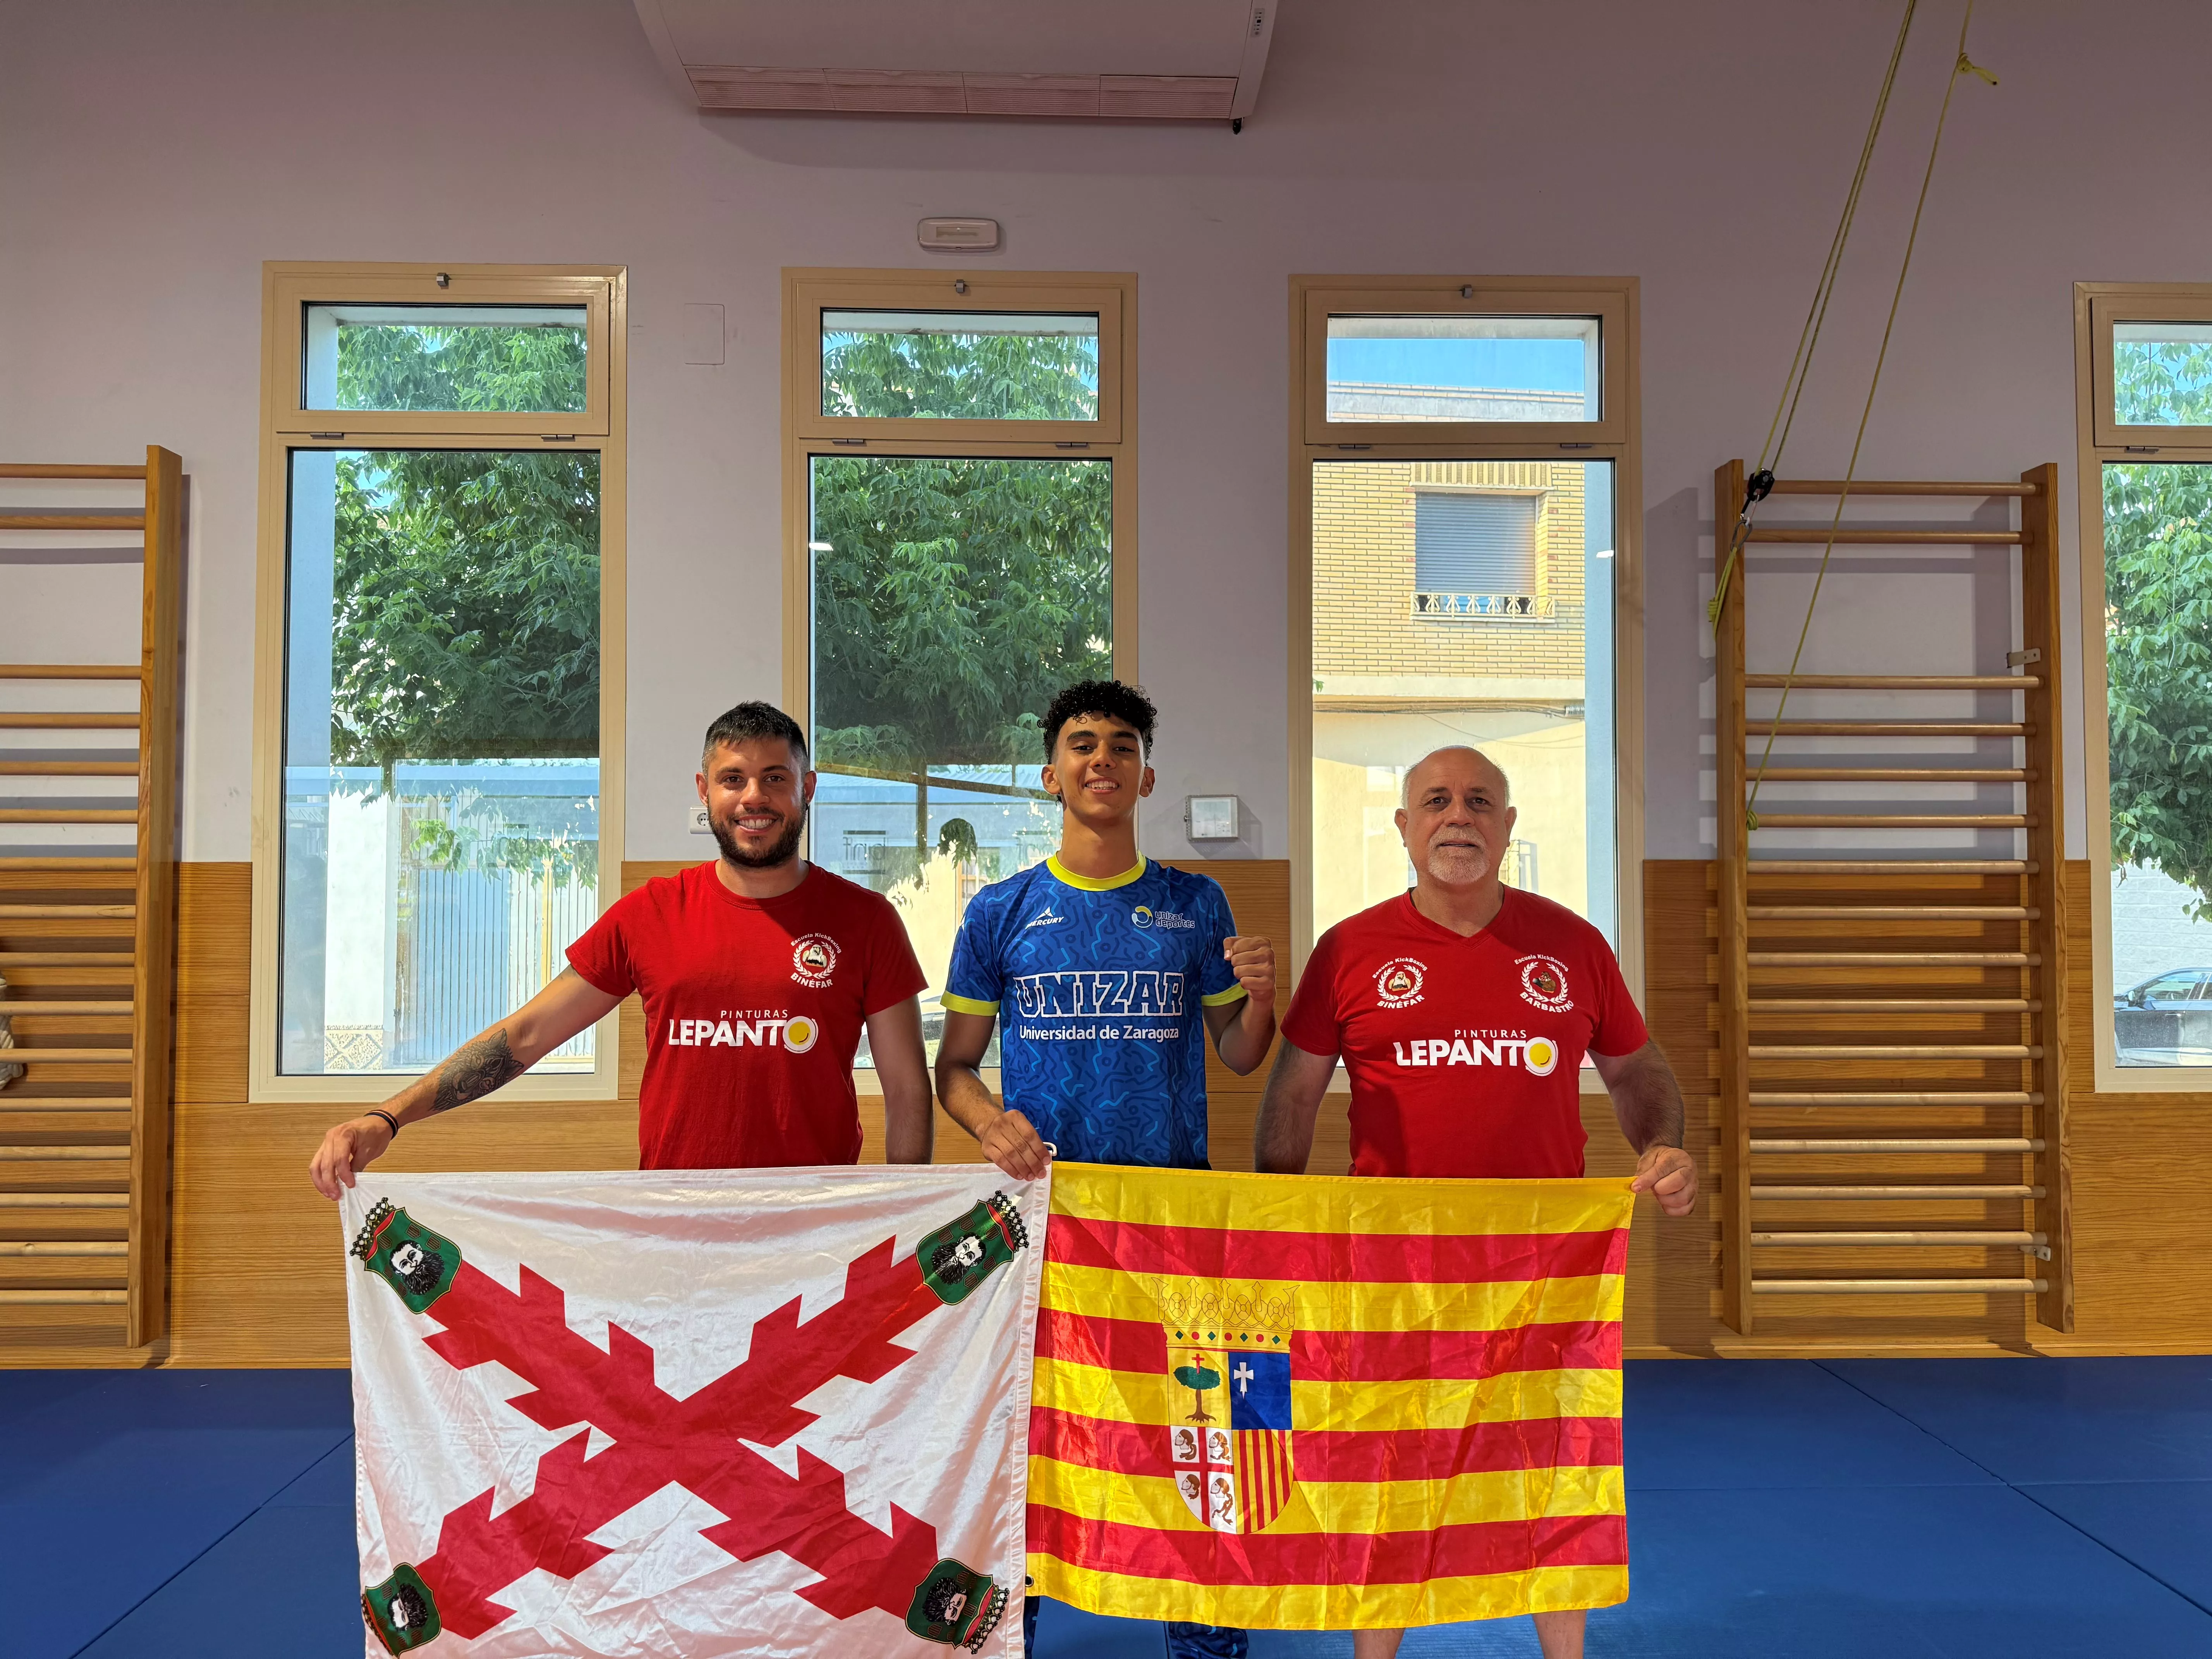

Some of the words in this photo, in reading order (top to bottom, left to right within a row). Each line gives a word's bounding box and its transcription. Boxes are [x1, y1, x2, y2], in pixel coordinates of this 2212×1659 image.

[1155, 911, 1183, 920] unizar
[1155, 919, 1195, 929] deportes
[790, 934, 813, 946] Escuela
[815, 933, 842, 954] KickBoxing
[1395, 957, 1428, 971] KickBoxing
[1514, 954, 1536, 965] Escuela
[1537, 954, 1569, 972] KickBoxing
[790, 972, 833, 988] BINÉFAR
[1013, 971, 1184, 1018] UNIZAR
[1377, 994, 1425, 1009] BINÉFAR
[1520, 991, 1574, 1013] BARBASTRO
[721, 1010, 788, 1019] PINTURAS
[1020, 1025, 1096, 1040] Universidad
[1099, 1025, 1119, 1039] de
[1123, 1025, 1179, 1042] Zaragoza
[1455, 1029, 1527, 1038] PINTURAS
